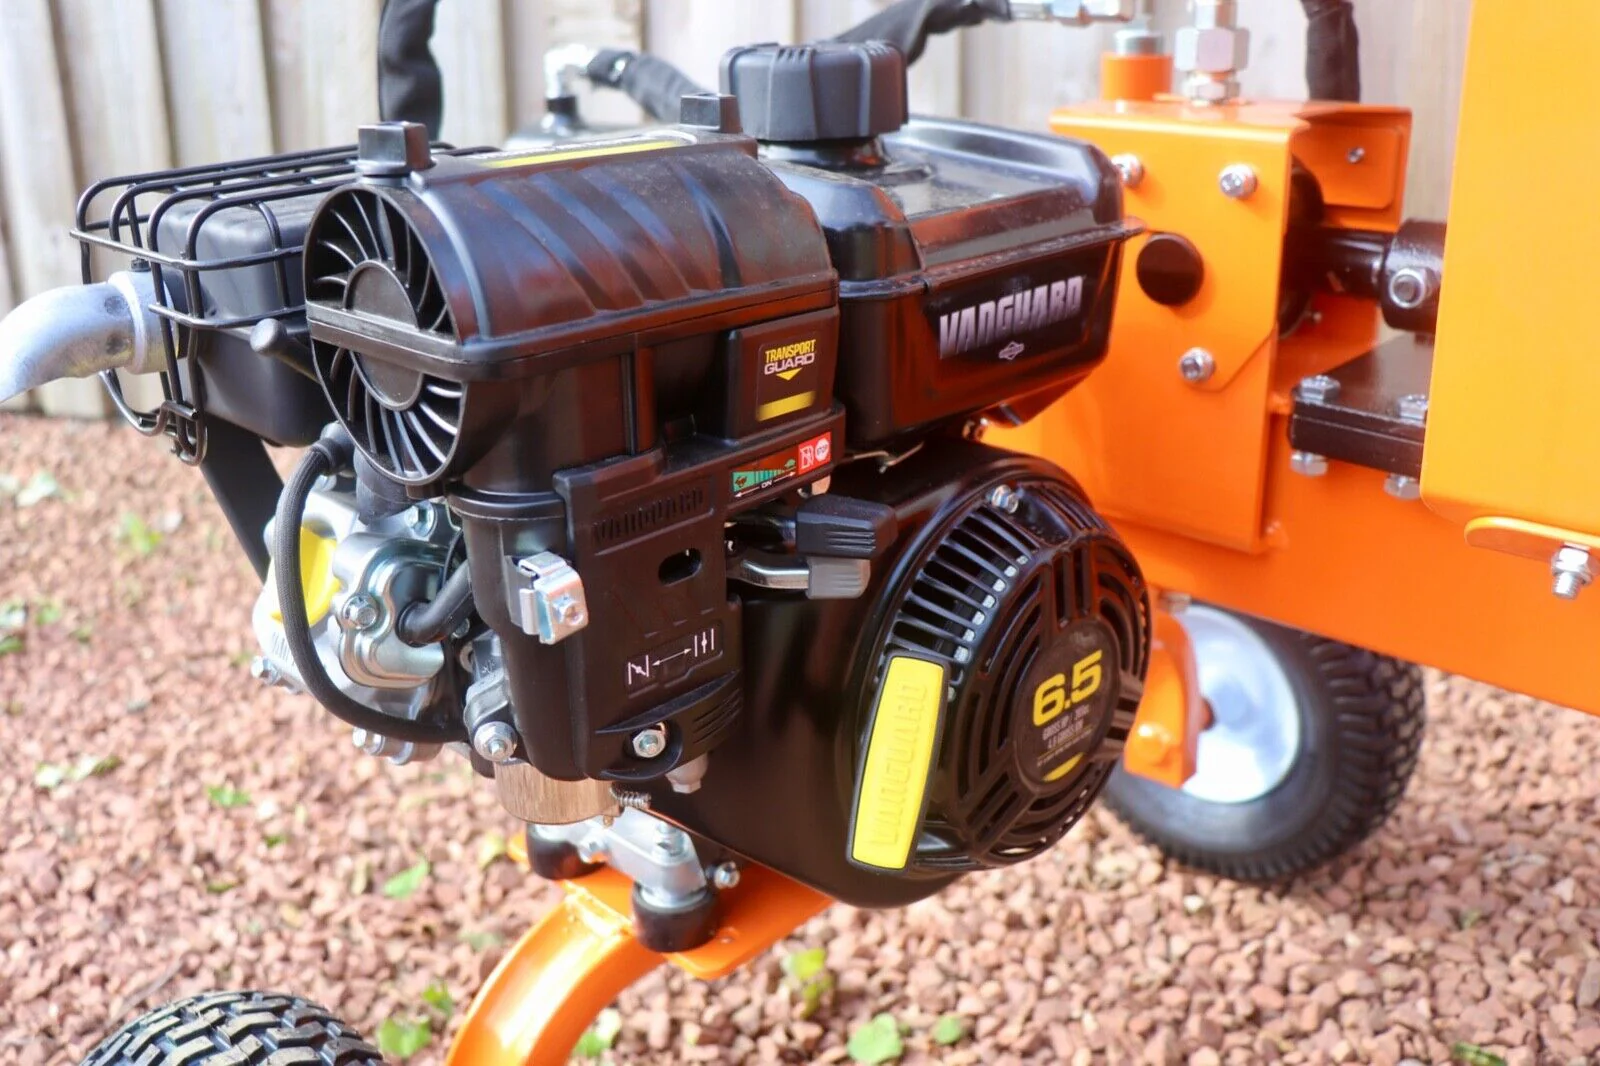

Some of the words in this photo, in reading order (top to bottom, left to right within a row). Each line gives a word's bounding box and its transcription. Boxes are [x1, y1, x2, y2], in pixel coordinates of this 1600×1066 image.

[939, 275, 1083, 359] VANGUARD
[765, 339, 816, 363] TRANSPORT
[764, 352, 815, 375] GUARD
[761, 480, 772, 488] ON
[1033, 649, 1102, 727] 6.5
